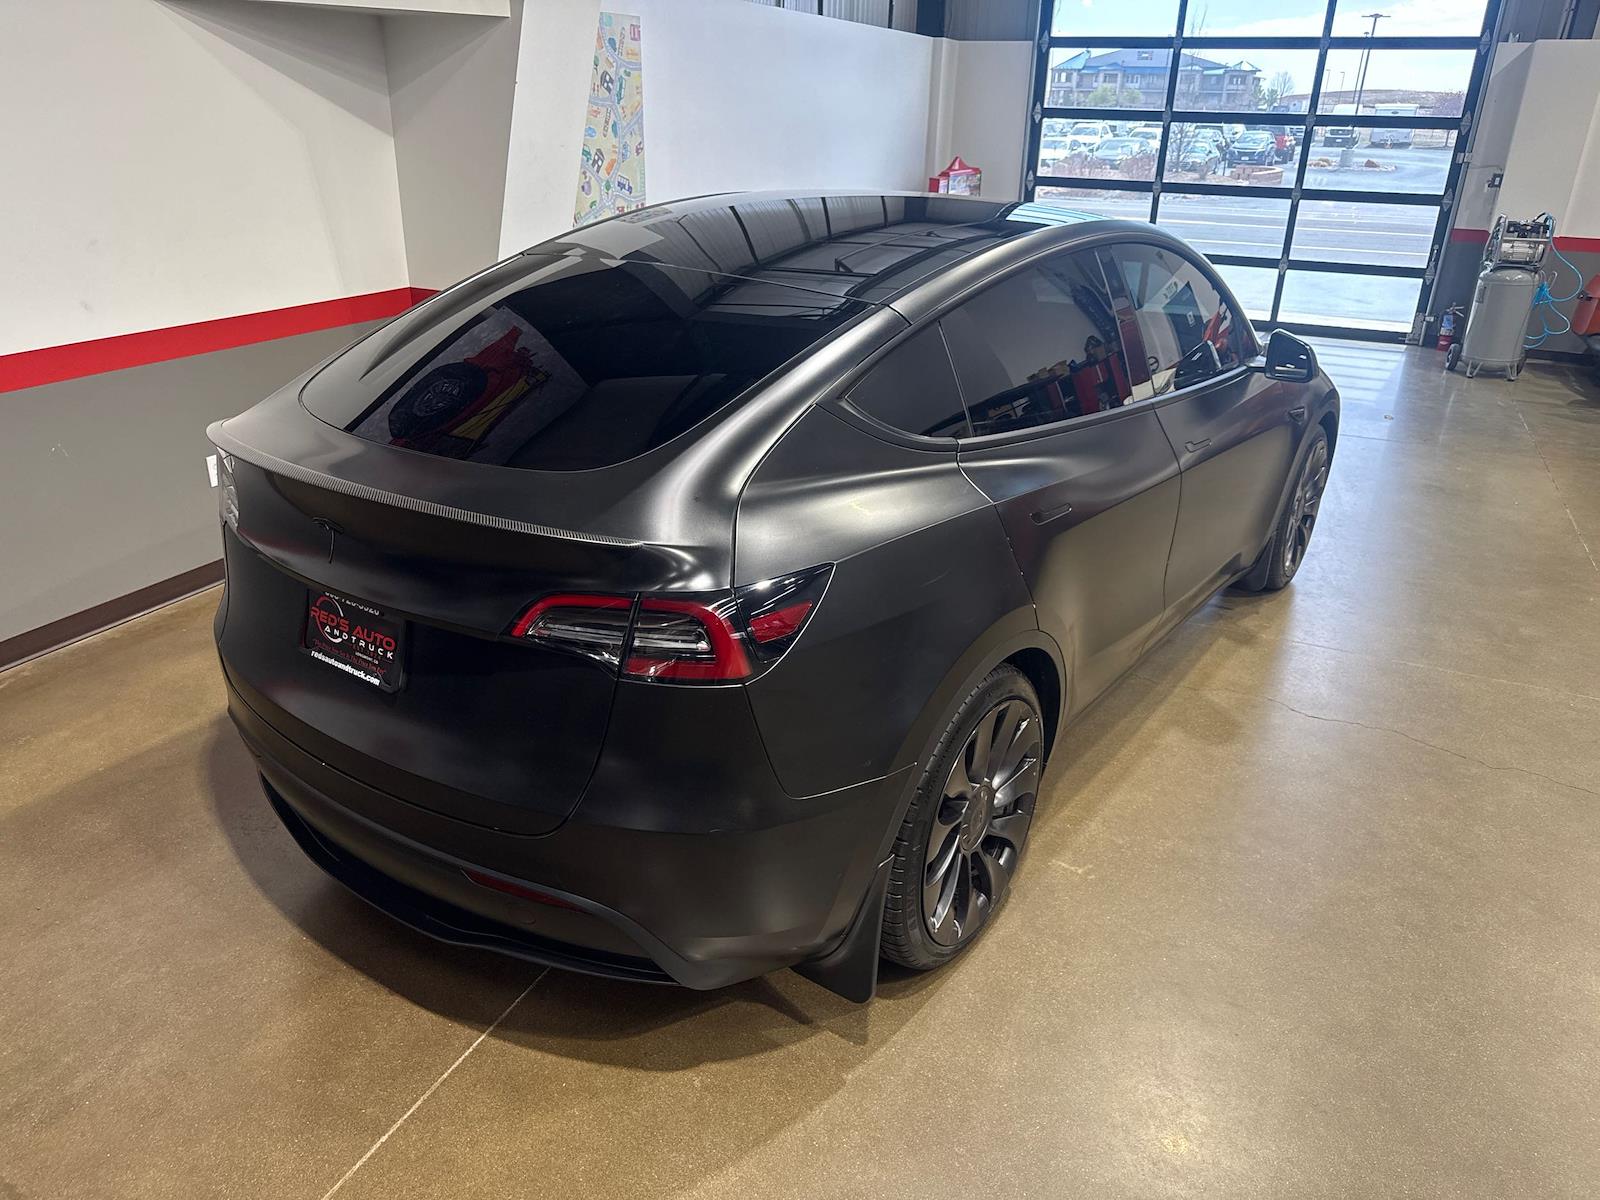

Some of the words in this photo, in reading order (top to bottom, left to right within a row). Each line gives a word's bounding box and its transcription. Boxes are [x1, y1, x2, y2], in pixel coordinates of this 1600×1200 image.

[310, 606, 350, 633] RED'S
[352, 625, 396, 651] AUTO
[311, 650, 381, 686] redsautoandtruck.com
